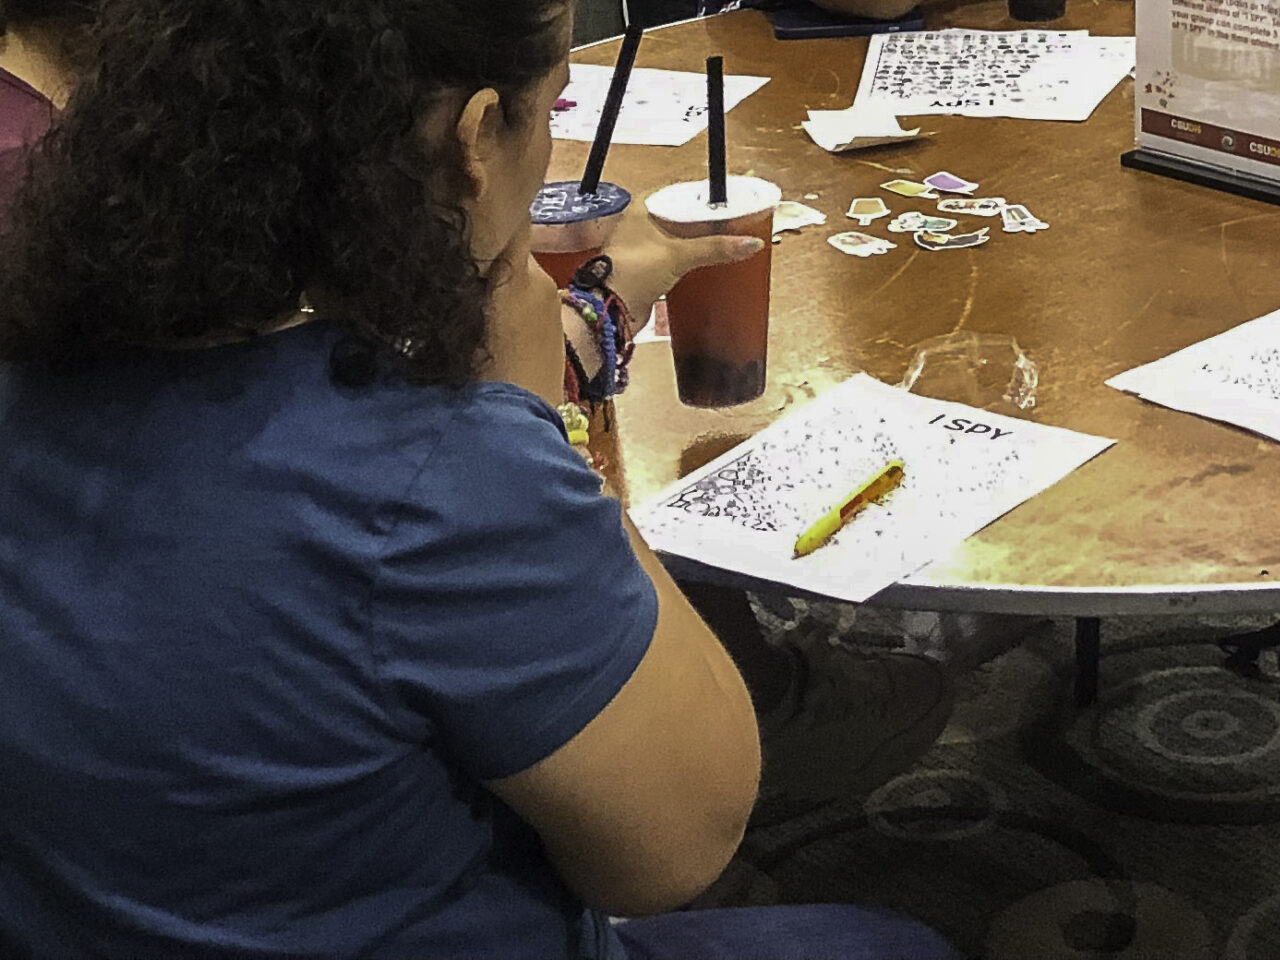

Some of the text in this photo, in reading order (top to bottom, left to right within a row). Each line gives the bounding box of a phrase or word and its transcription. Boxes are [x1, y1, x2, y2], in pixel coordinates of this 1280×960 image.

[1170, 119, 1202, 134] CSUDH
[928, 413, 1014, 440] I SPY
